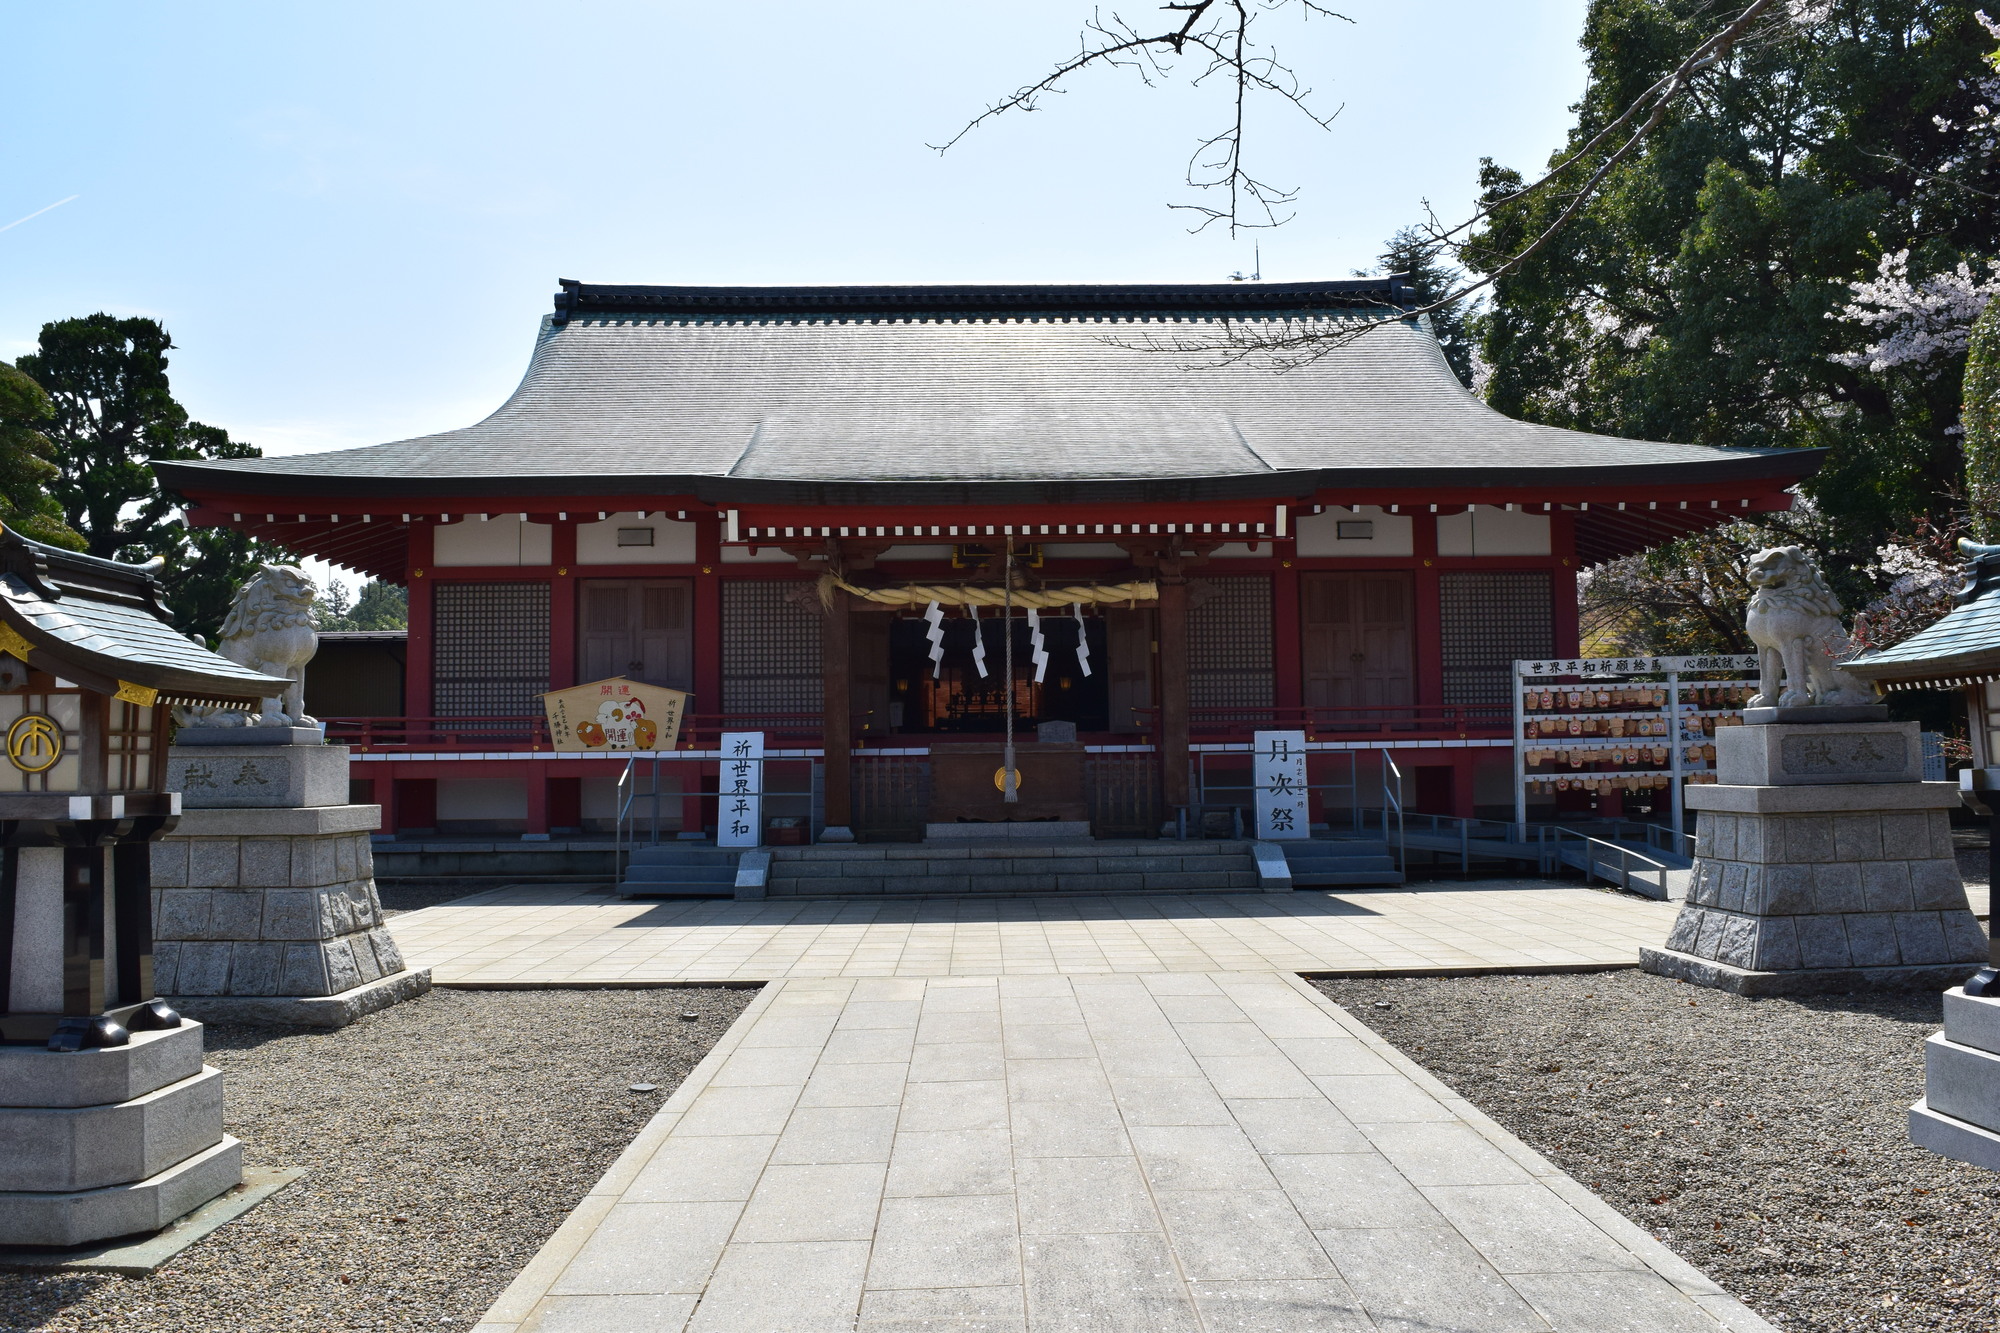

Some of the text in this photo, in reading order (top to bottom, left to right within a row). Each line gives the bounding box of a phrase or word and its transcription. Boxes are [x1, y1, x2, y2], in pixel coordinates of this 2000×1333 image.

[1532, 658, 1663, 674] 世界平和祈願絵馬
[600, 685, 631, 696] 開運
[605, 728, 628, 742] 開運
[665, 699, 676, 739] 祈世界平和
[730, 739, 752, 838] 祈世界平和
[1268, 739, 1295, 832] 月次祭
[1296, 749, 1304, 809] 月十七日十一時
